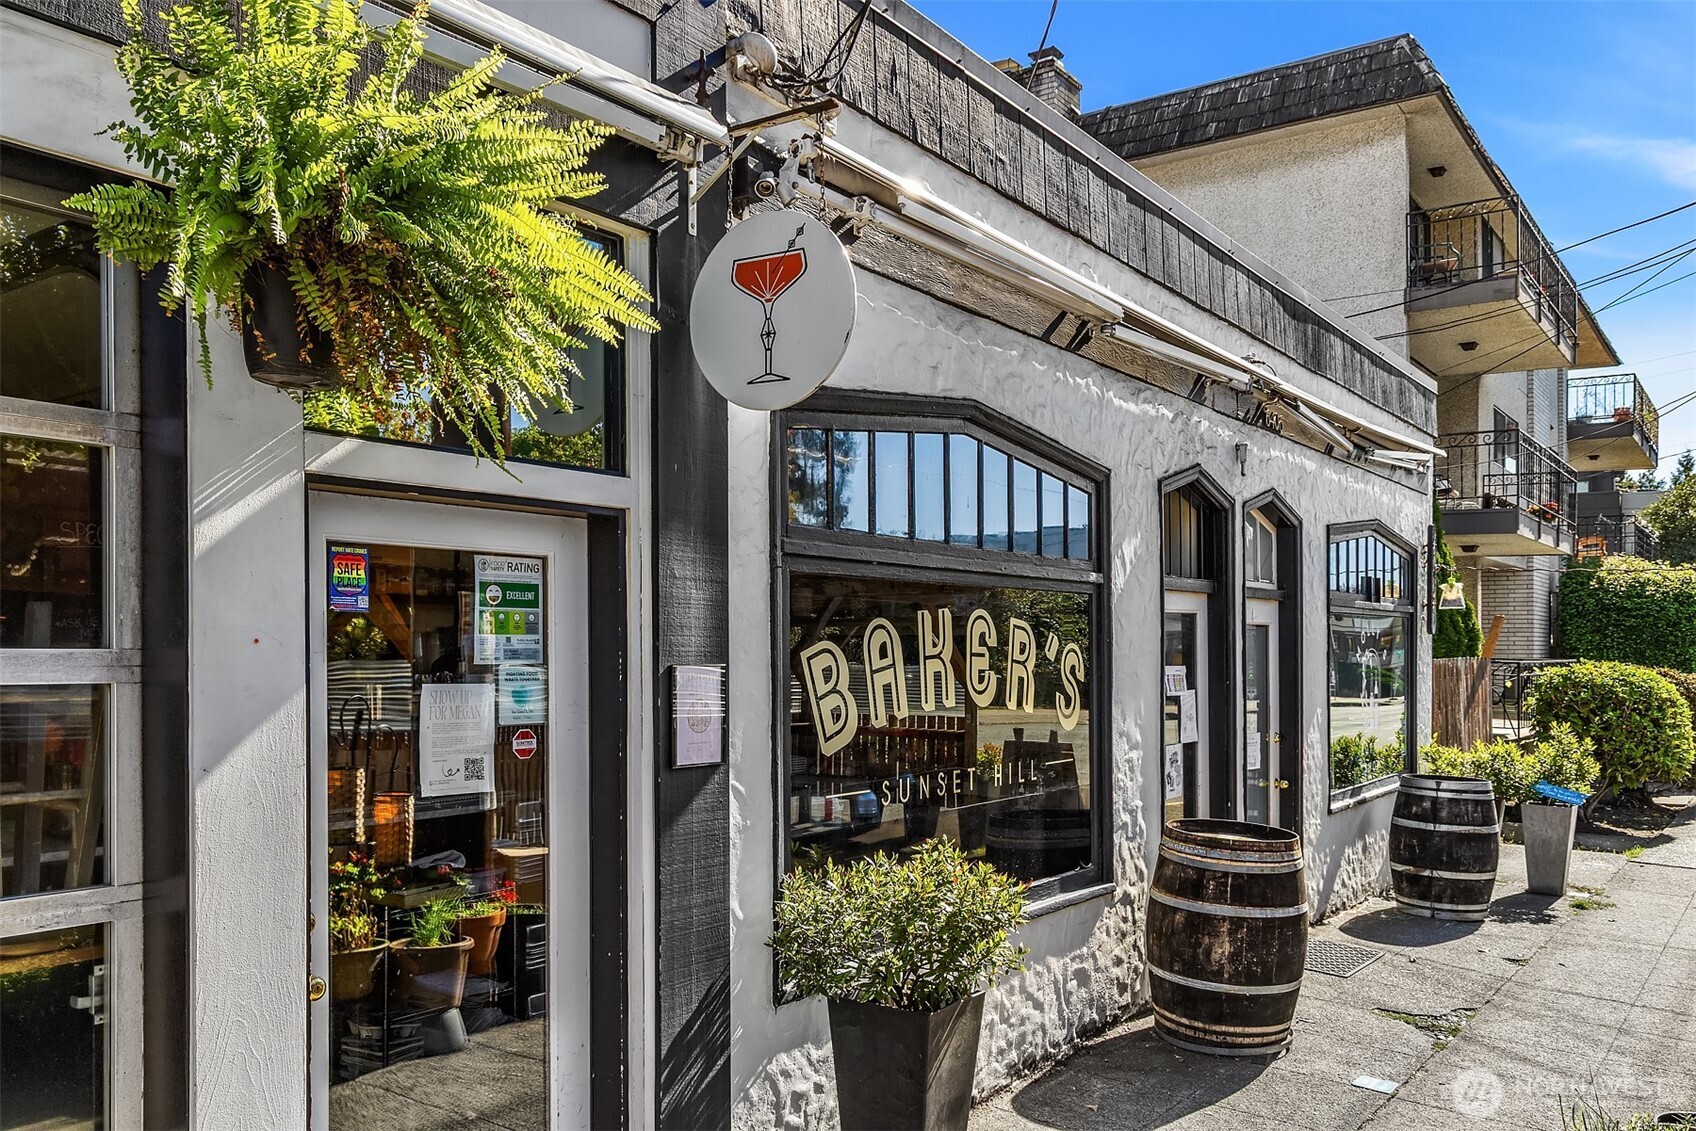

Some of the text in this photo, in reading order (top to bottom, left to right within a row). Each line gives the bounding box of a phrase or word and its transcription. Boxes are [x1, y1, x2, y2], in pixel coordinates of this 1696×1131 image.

[337, 561, 362, 576] SAFE
[507, 562, 540, 574] RATING
[337, 576, 362, 588] PLACE
[506, 591, 535, 600] EXCELLENT
[800, 607, 1085, 757] BAKER'S
[429, 689, 473, 705] SHOW UP
[429, 704, 482, 720] FOR MEGAN
[881, 768, 976, 807] SUNSET
[994, 759, 1038, 787] HILL
